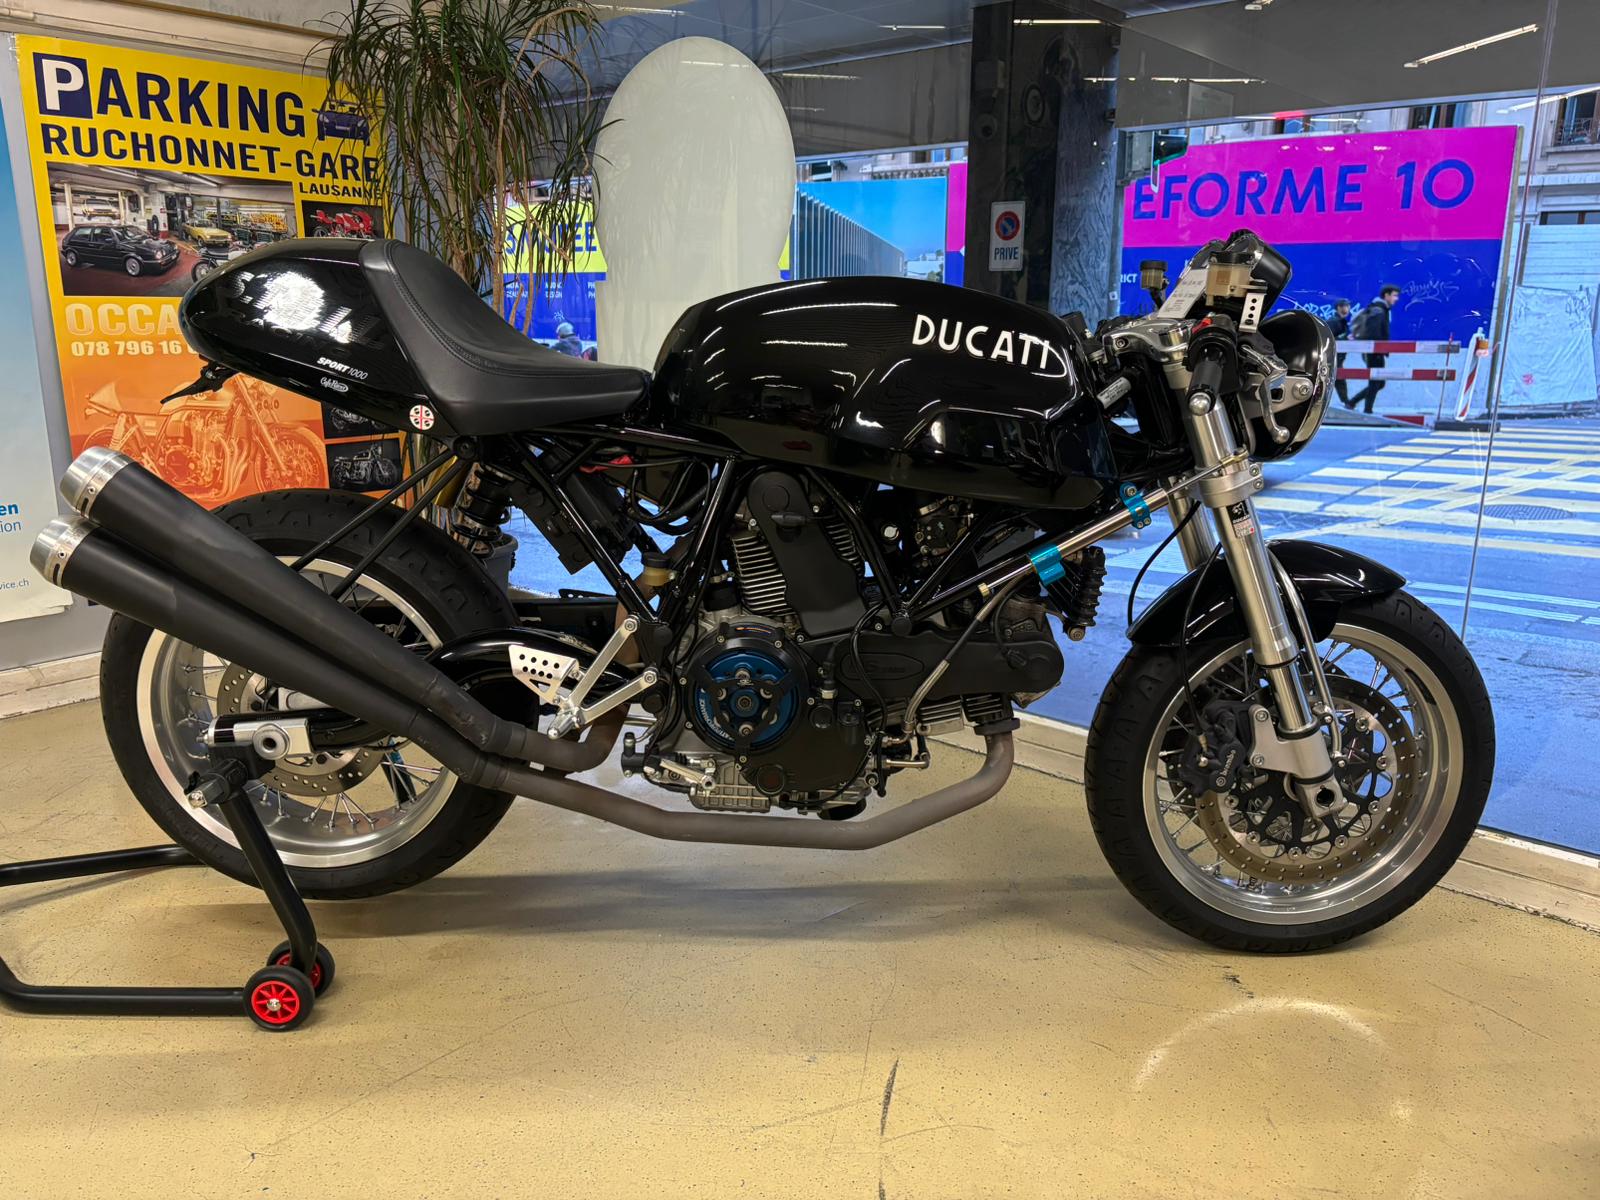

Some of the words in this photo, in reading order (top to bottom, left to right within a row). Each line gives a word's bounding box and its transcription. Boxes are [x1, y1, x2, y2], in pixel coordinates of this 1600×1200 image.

[41, 58, 306, 138] PARKING
[41, 123, 380, 183] RUCHONNET-GARE
[1395, 158, 1475, 210] 10
[994, 246, 1020, 261] PRIVE
[71, 341, 110, 356] 078
[114, 340, 154, 355] 796
[159, 340, 182, 355] 16
[912, 314, 1050, 369] DUCATI
[317, 357, 350, 372] SPORT
[349, 367, 369, 381] 1000
[0, 520, 21, 533] ion
